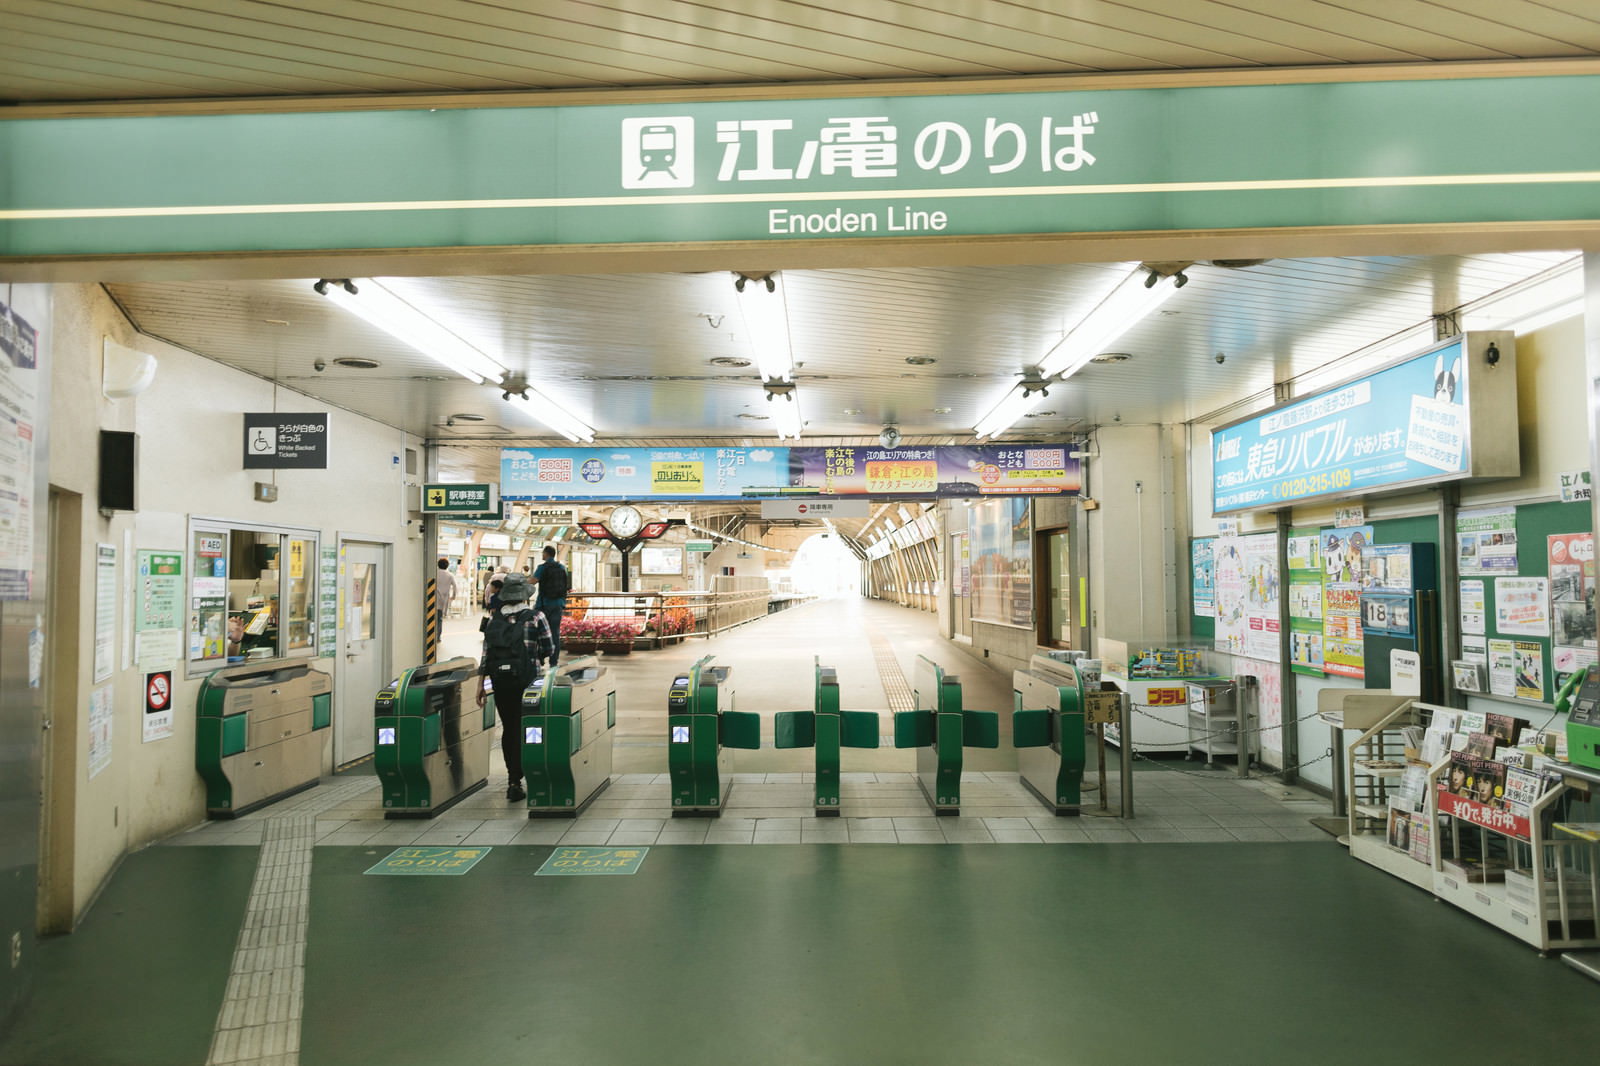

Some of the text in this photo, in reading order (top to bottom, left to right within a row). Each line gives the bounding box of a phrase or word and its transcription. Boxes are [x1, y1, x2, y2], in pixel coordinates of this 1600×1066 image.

[768, 206, 947, 234] Enoden Line
[278, 424, 325, 433] うらが白色の
[278, 433, 302, 443] きっぷ
[998, 450, 1061, 459] おとな 1000円
[835, 448, 845, 476] 江の島
[845, 448, 855, 476] 午後の
[998, 459, 1061, 468] こども 500円
[1281, 468, 1351, 498] 0120-215-109
[449, 490, 485, 500] 駅事務室
[207, 540, 221, 549] AED
[1369, 604, 1386, 622] 18
[395, 849, 481, 858] 江ノ電
[558, 849, 640, 858] 江ノ電
[387, 859, 467, 867] のりば
[552, 858, 633, 867] のりば
